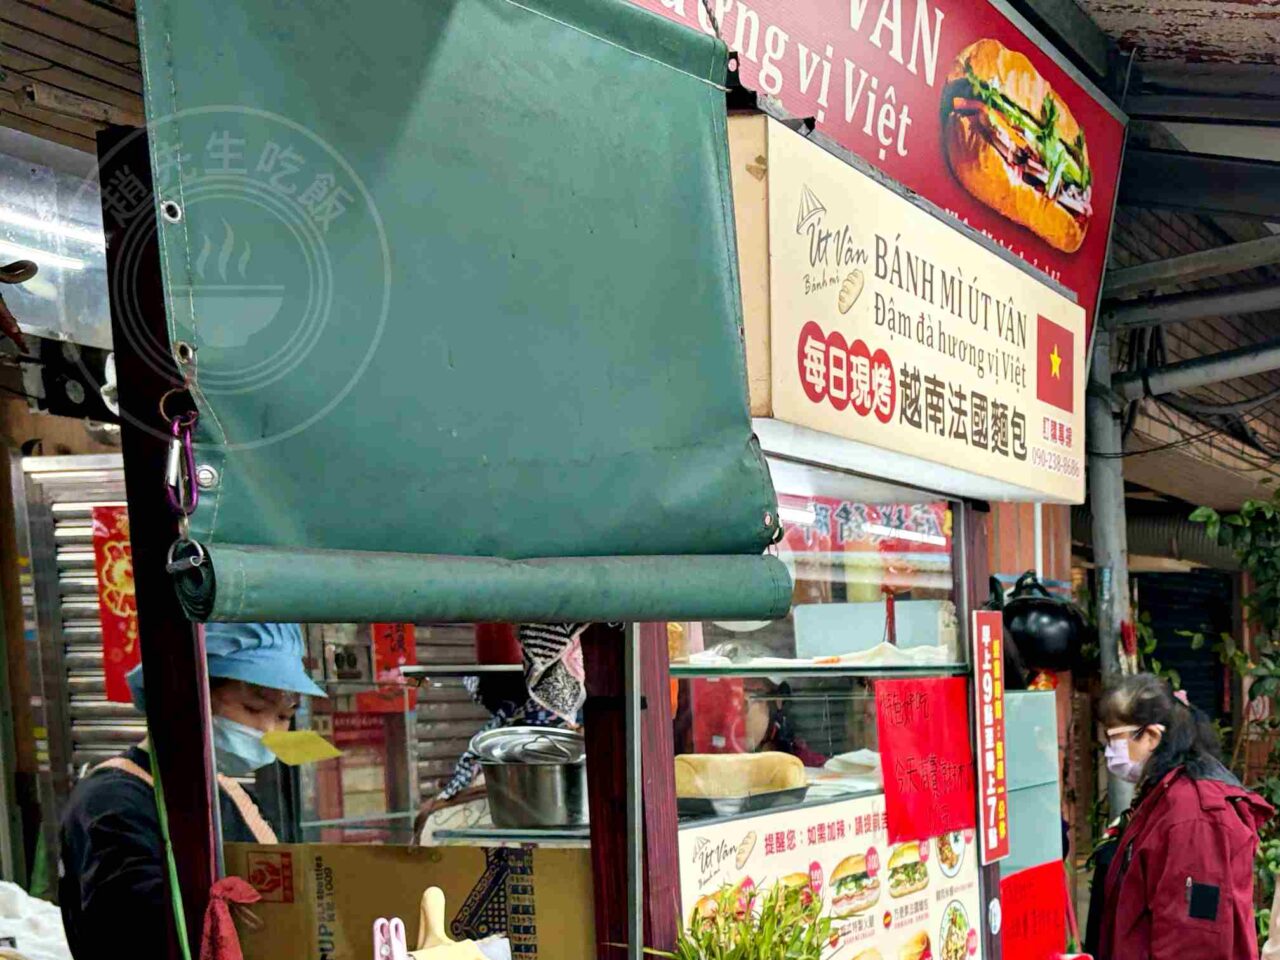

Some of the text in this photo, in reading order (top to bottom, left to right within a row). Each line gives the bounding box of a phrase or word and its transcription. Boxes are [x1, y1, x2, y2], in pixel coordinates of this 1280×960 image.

[843, 58, 912, 161] Việt
[875, 233, 934, 305] BÁNH
[940, 266, 963, 319] MÌ
[968, 276, 993, 331] ÚT
[995, 296, 1028, 350] VÂN
[803, 336, 893, 416] 每日現烤
[874, 292, 912, 341] Đậm
[916, 312, 934, 350] đà
[938, 319, 985, 379] hương
[1001, 350, 1028, 393] Việt
[899, 361, 1029, 462] 越南法國麵包
